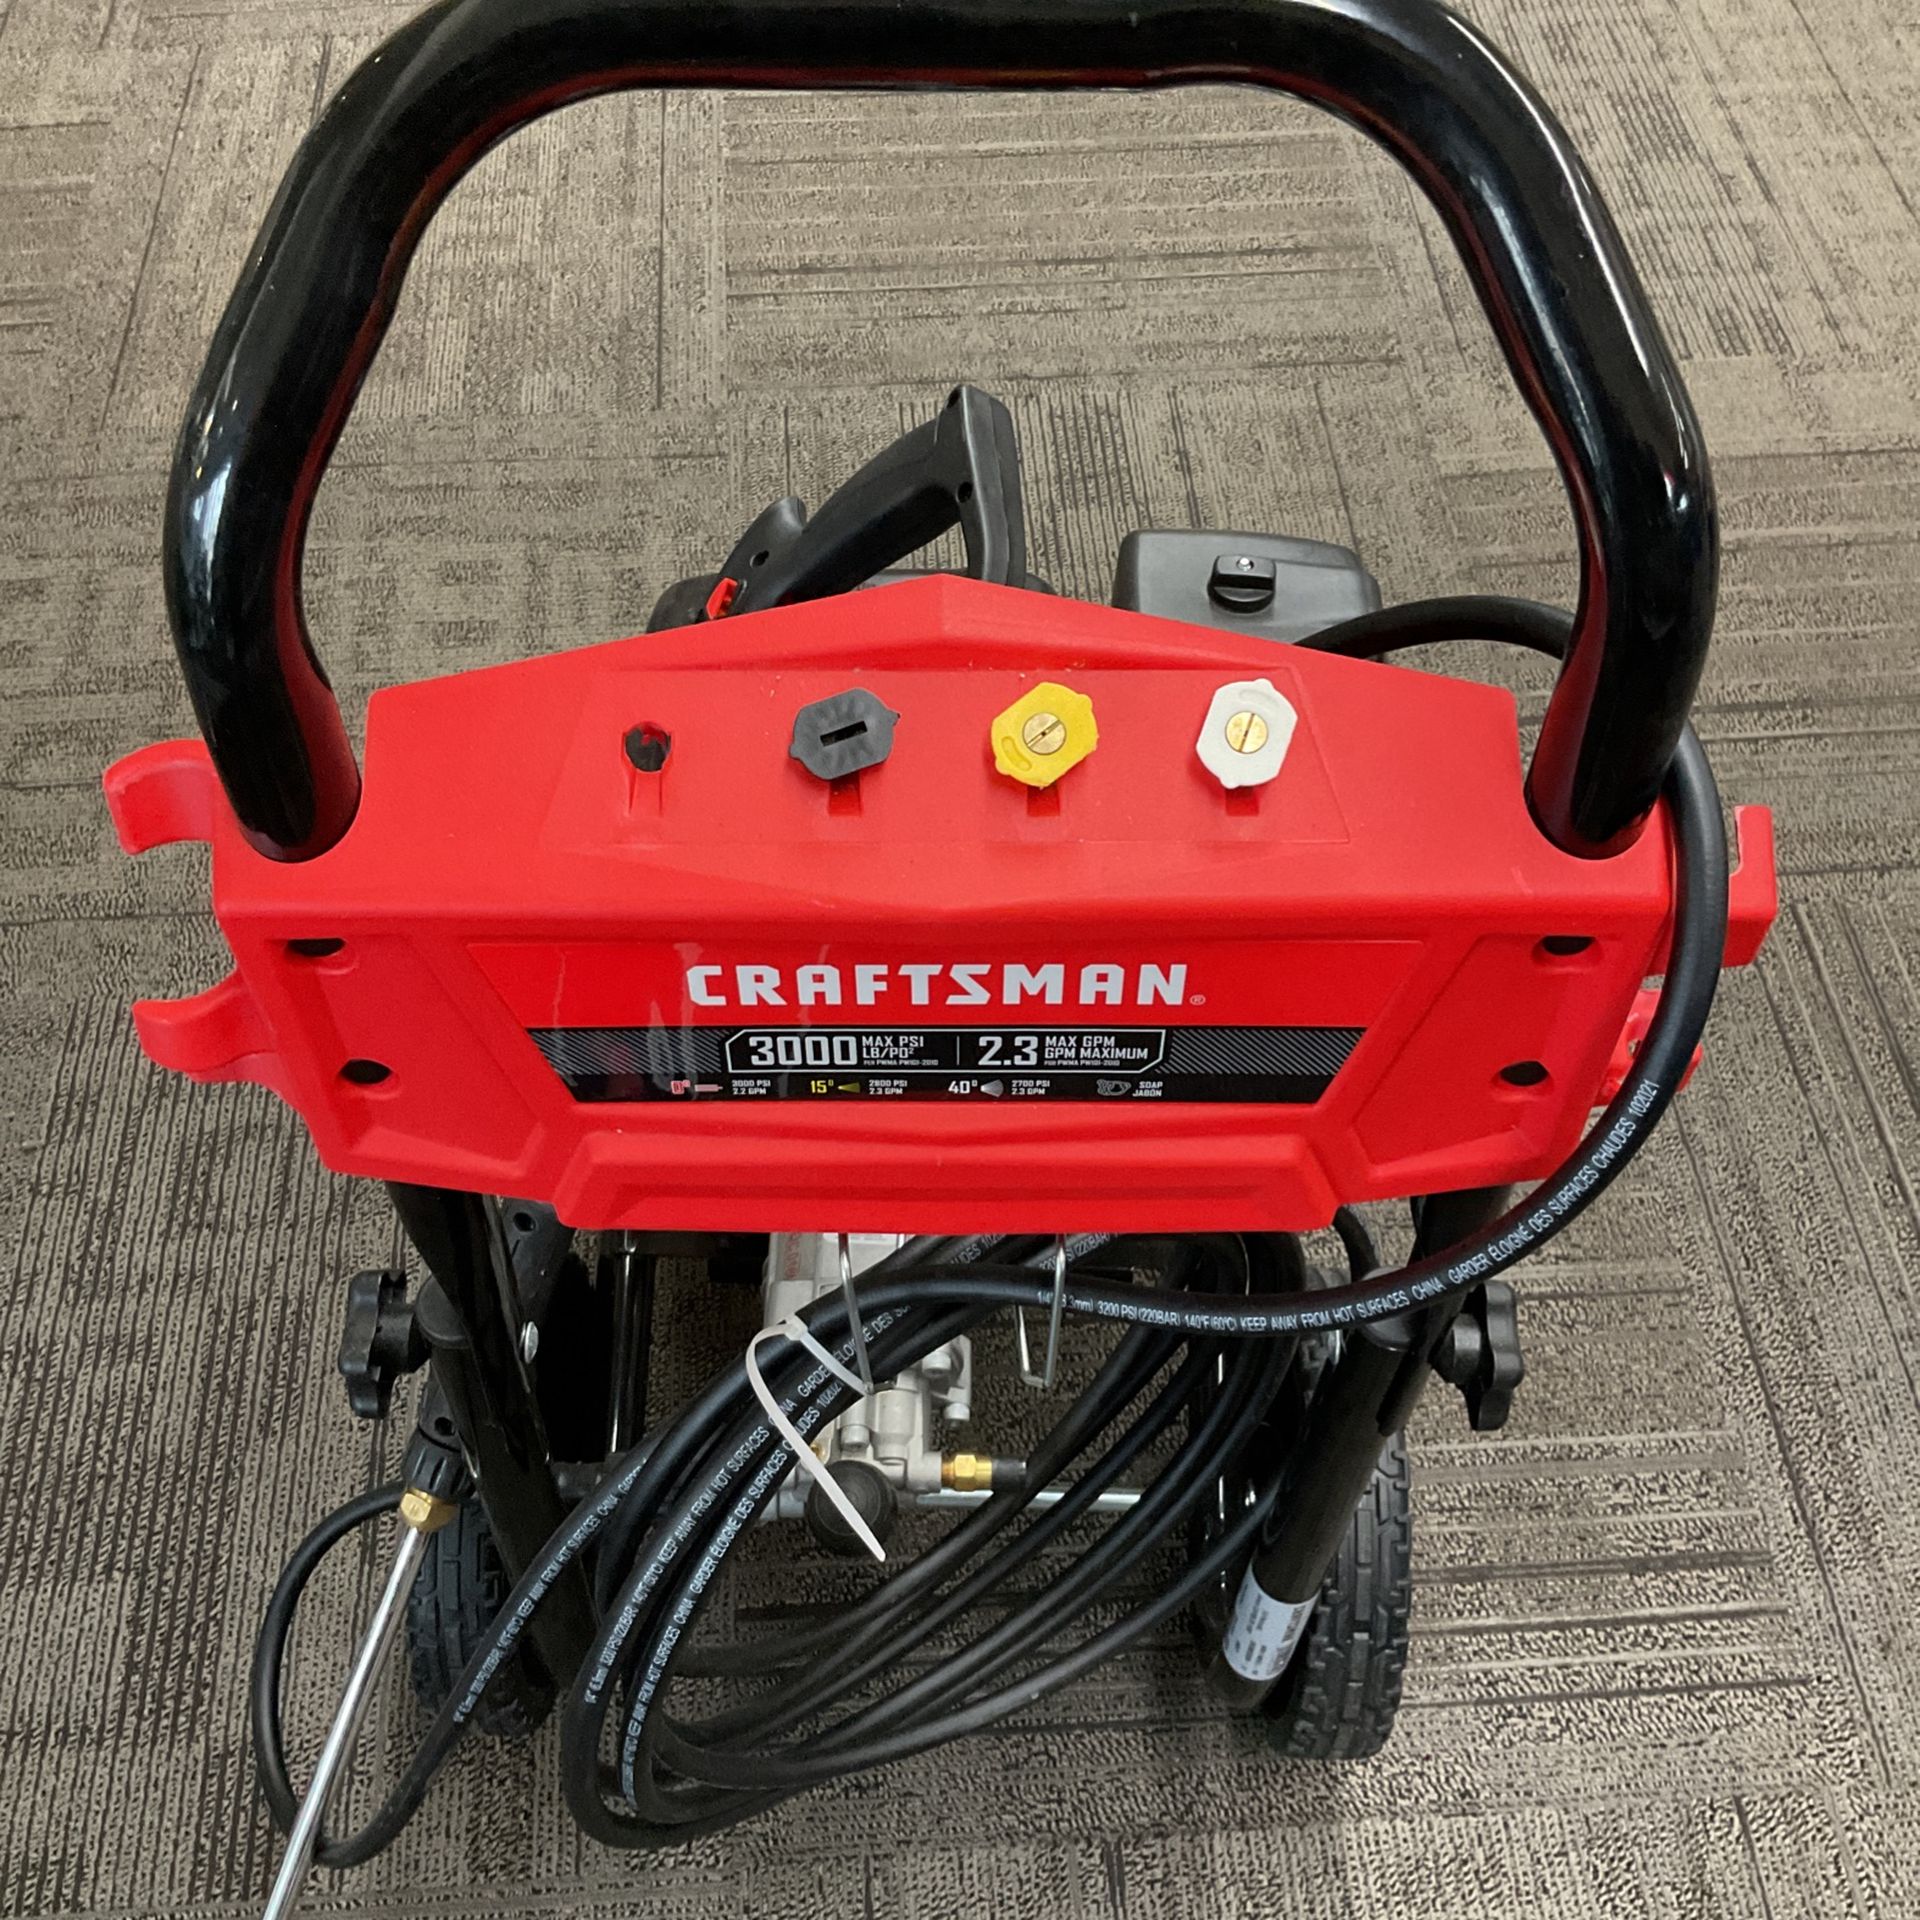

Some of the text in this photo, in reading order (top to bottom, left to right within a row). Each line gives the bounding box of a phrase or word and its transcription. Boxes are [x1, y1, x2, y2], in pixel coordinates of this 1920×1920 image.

[862, 1035, 925, 1048] MAX PSI
[1045, 1035, 1116, 1048] MAX GPM
[748, 1036, 858, 1066] 3000
[977, 1036, 1039, 1066] 2.3
[1044, 1047, 1149, 1060] GPM MAXIMUM
[731, 1079, 771, 1088] 3000 PSI
[893, 1079, 908, 1088] PSI
[1011, 1079, 1051, 1088] 2700 PSI
[1138, 1080, 1164, 1089] SOAP
[748, 1087, 767, 1096] GPM
[869, 1087, 904, 1096] 2.3 GPM
[1011, 1087, 1046, 1096] 2.3 GPM
[1097, 1300, 1120, 1318] 3200
[1121, 1304, 1137, 1320] PSI
[1240, 1316, 1267, 1331] KEEP
[1271, 1315, 1298, 1331] AWAY
[1300, 1311, 1332, 1329] FROM
[1334, 1305, 1355, 1324] HOT
[1355, 1291, 1411, 1319] SURFACES
[1411, 1277, 1447, 1301] CHINA
[1448, 1252, 1493, 1286] GARDER
[1528, 1208, 1554, 1233] DES
[1548, 1164, 1600, 1216] SURFACES
[1591, 1116, 1637, 1169] CHAUDES
[1627, 1078, 1660, 1118] 102021
[657, 1538, 679, 1564] KEEP
[674, 1513, 698, 1542] AWAY
[691, 1486, 718, 1517] FROM
[711, 1467, 733, 1492] HOT
[726, 1425, 771, 1473] SURFACES
[796, 1364, 832, 1399] GARDE
[871, 1311, 894, 1334] DES
[653, 1625, 681, 1668] SURFACES
[673, 1597, 696, 1626] CHINA
[689, 1554, 720, 1595] GARDER
[734, 1496, 756, 1520] DES
[748, 1449, 788, 1500] SURFACES
